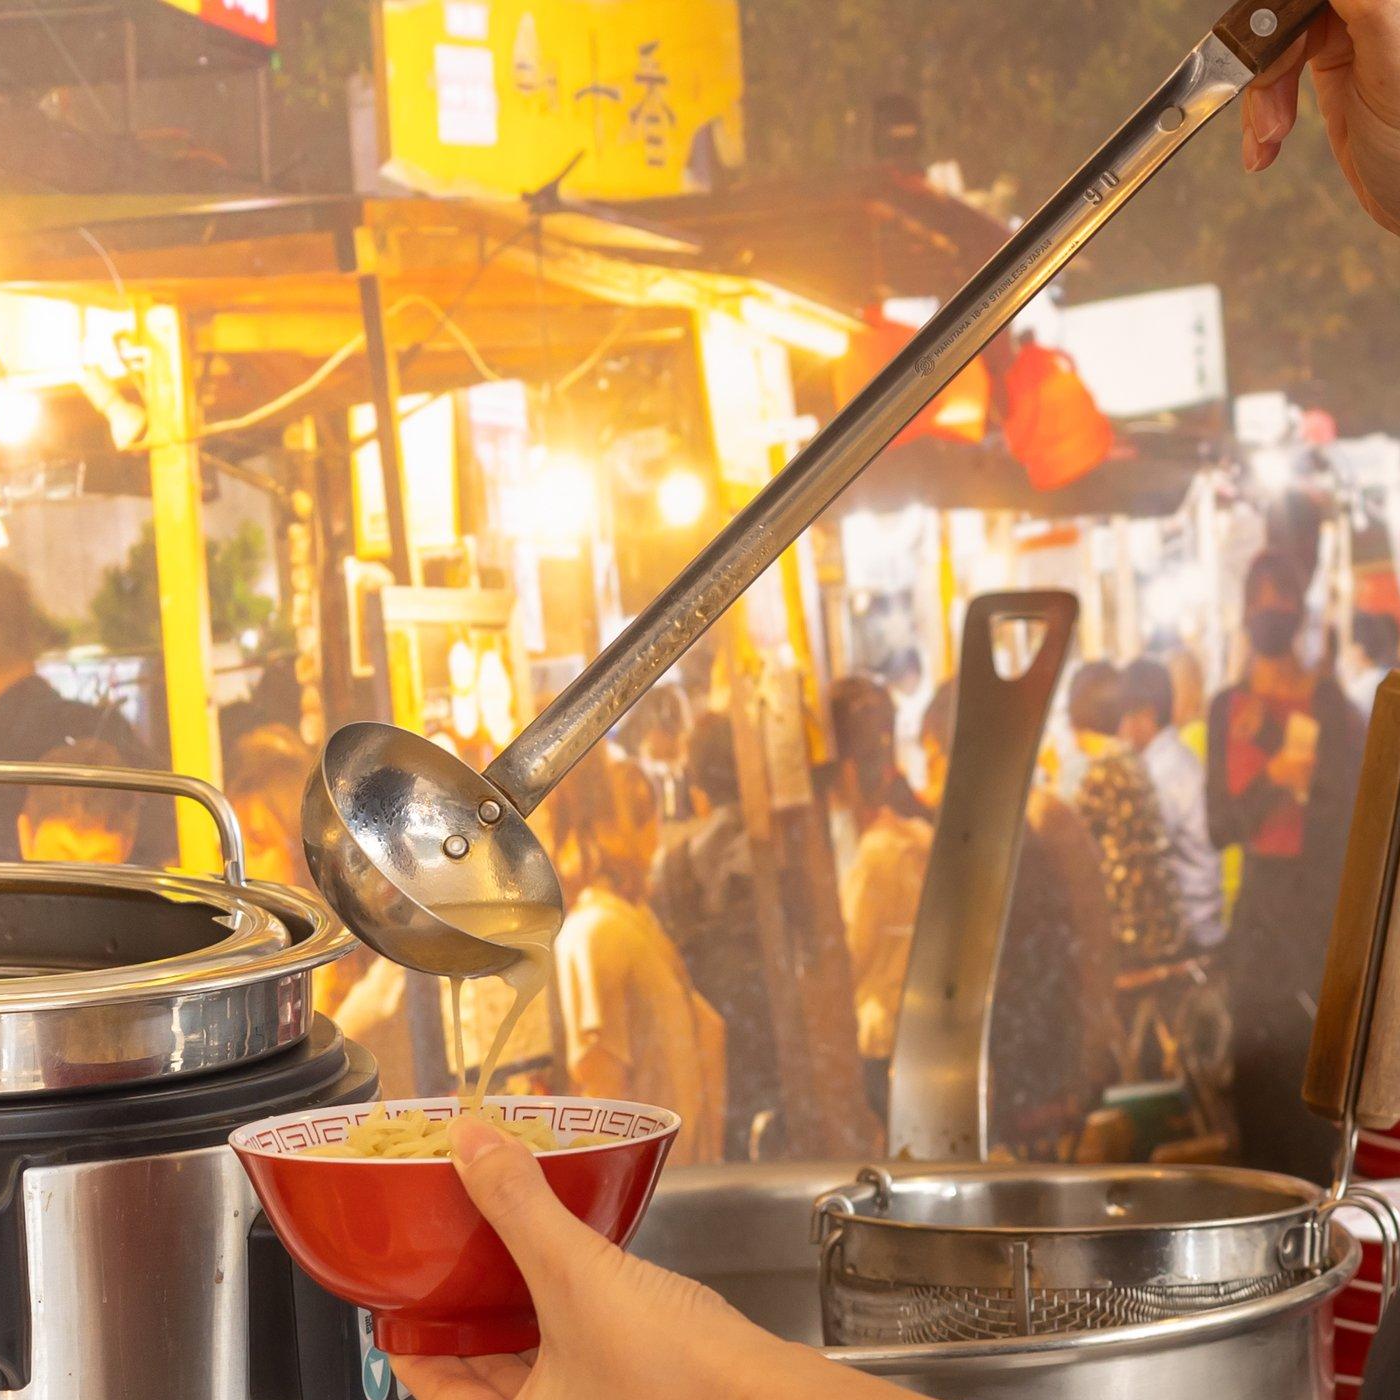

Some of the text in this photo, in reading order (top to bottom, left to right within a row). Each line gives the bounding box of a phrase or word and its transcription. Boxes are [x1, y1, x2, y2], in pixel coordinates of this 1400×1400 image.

[934, 320, 972, 358] MARUTAMA
[990, 264, 1028, 302] STAINLESS
[1027, 239, 1053, 265] JAPAN
